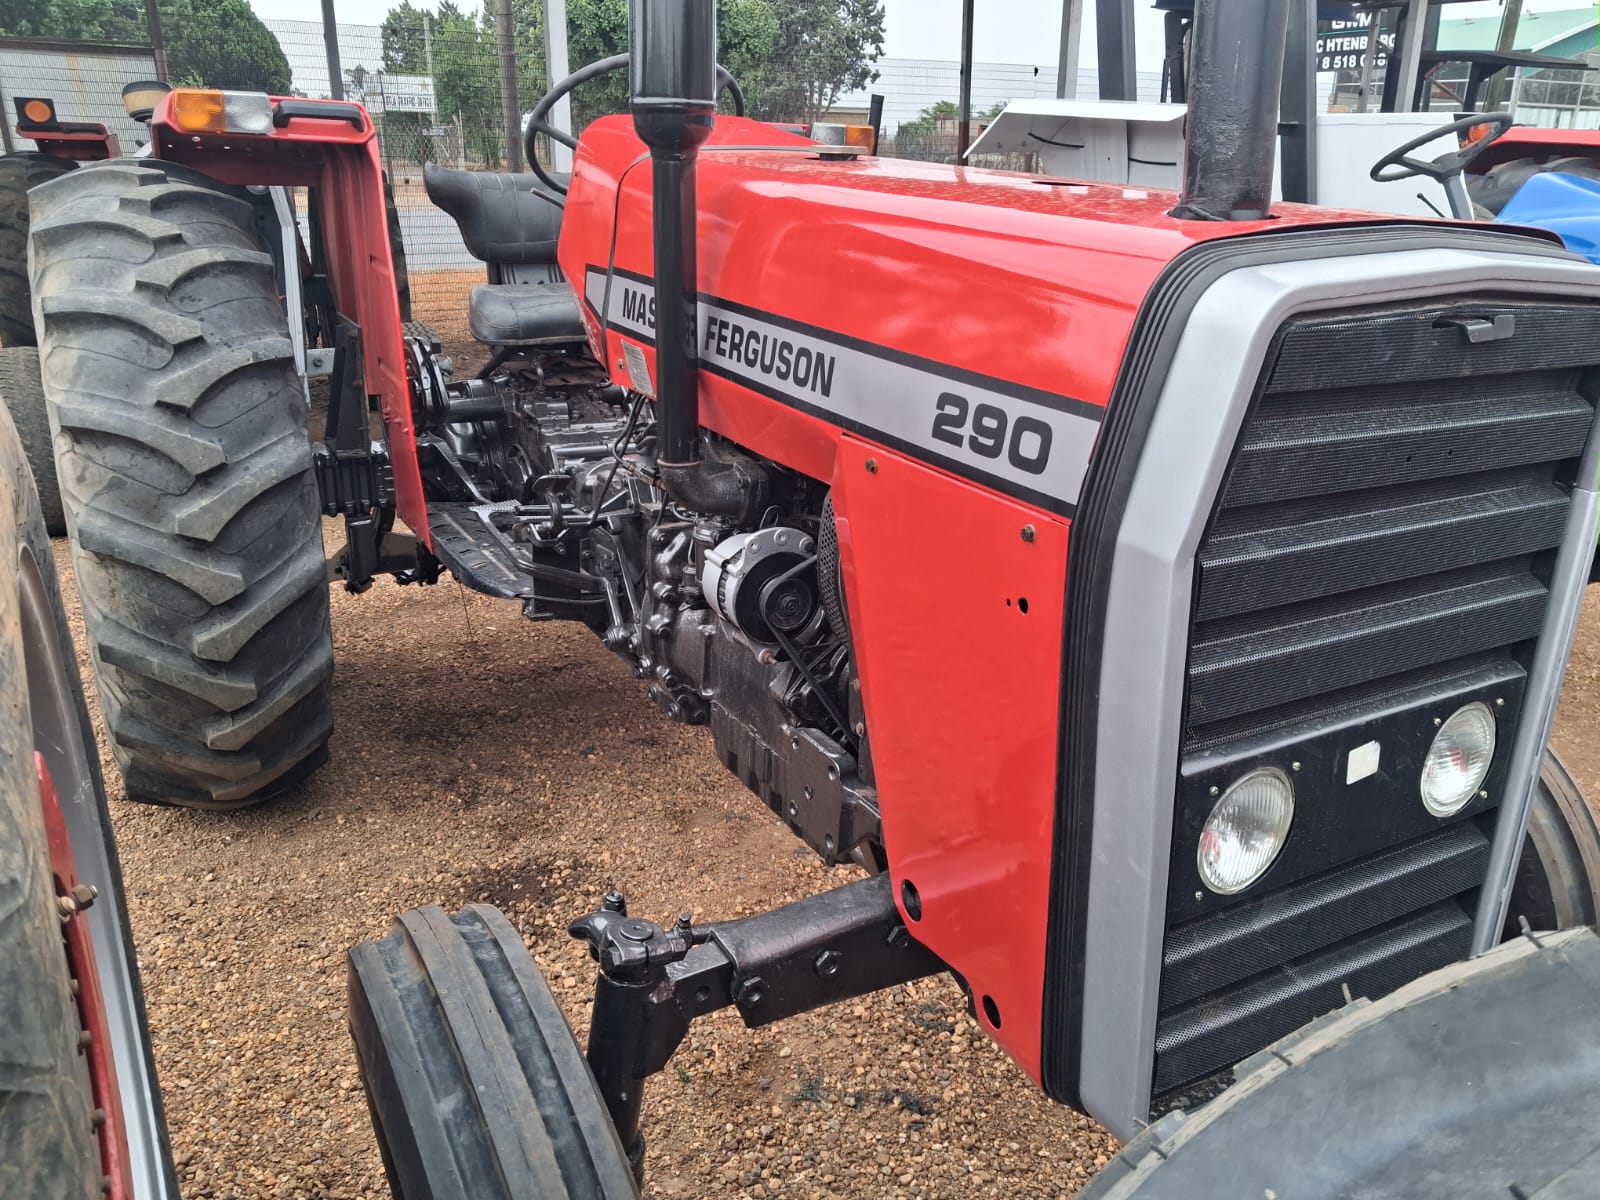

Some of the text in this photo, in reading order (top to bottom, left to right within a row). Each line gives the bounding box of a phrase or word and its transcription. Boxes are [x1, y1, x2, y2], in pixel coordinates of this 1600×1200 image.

[1333, 54, 1357, 69] 518
[622, 287, 656, 330] MAS
[704, 315, 835, 398] FERGUSON
[931, 391, 1053, 475] 290
